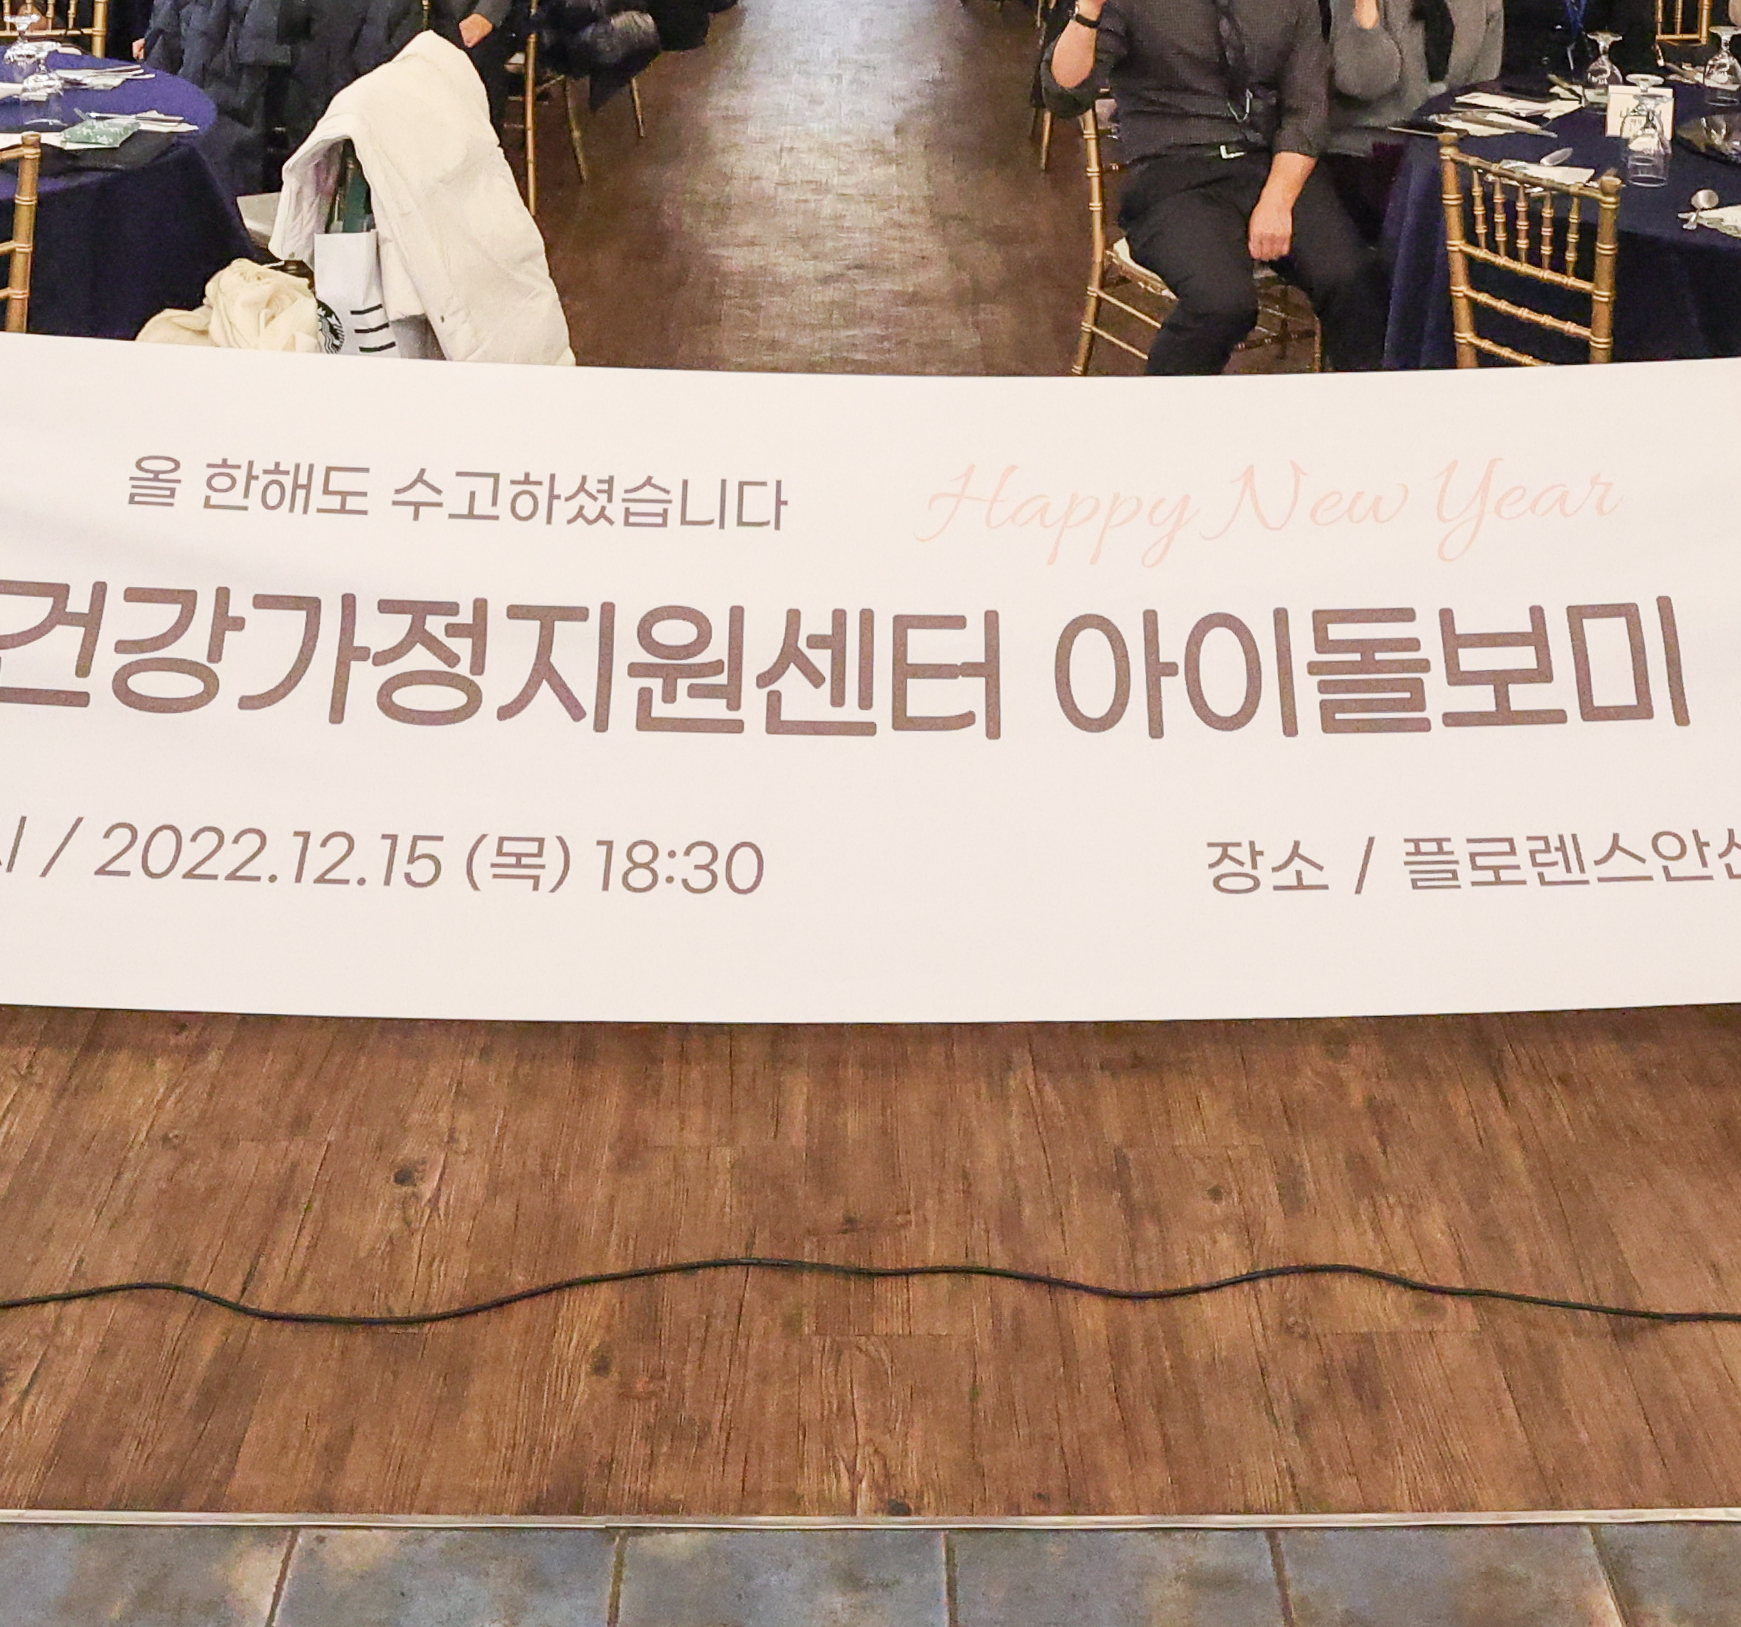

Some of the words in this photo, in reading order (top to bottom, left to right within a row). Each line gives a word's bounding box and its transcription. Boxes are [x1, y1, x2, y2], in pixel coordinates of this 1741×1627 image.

[126, 454, 183, 508] 올
[203, 458, 370, 516] 한해도
[391, 467, 789, 531] 수고하셨습니다
[913, 462, 1201, 569] Happy
[1198, 458, 1410, 542] New
[1430, 457, 1624, 563] Year
[1053, 594, 1691, 740] 아이돌보미
[40, 816, 85, 878] /
[94, 822, 445, 889] 2022.12.15
[464, 832, 572, 894] (목)
[595, 838, 766, 896] 18:30
[1205, 838, 1330, 895] 장소
[1354, 835, 1377, 895] /
